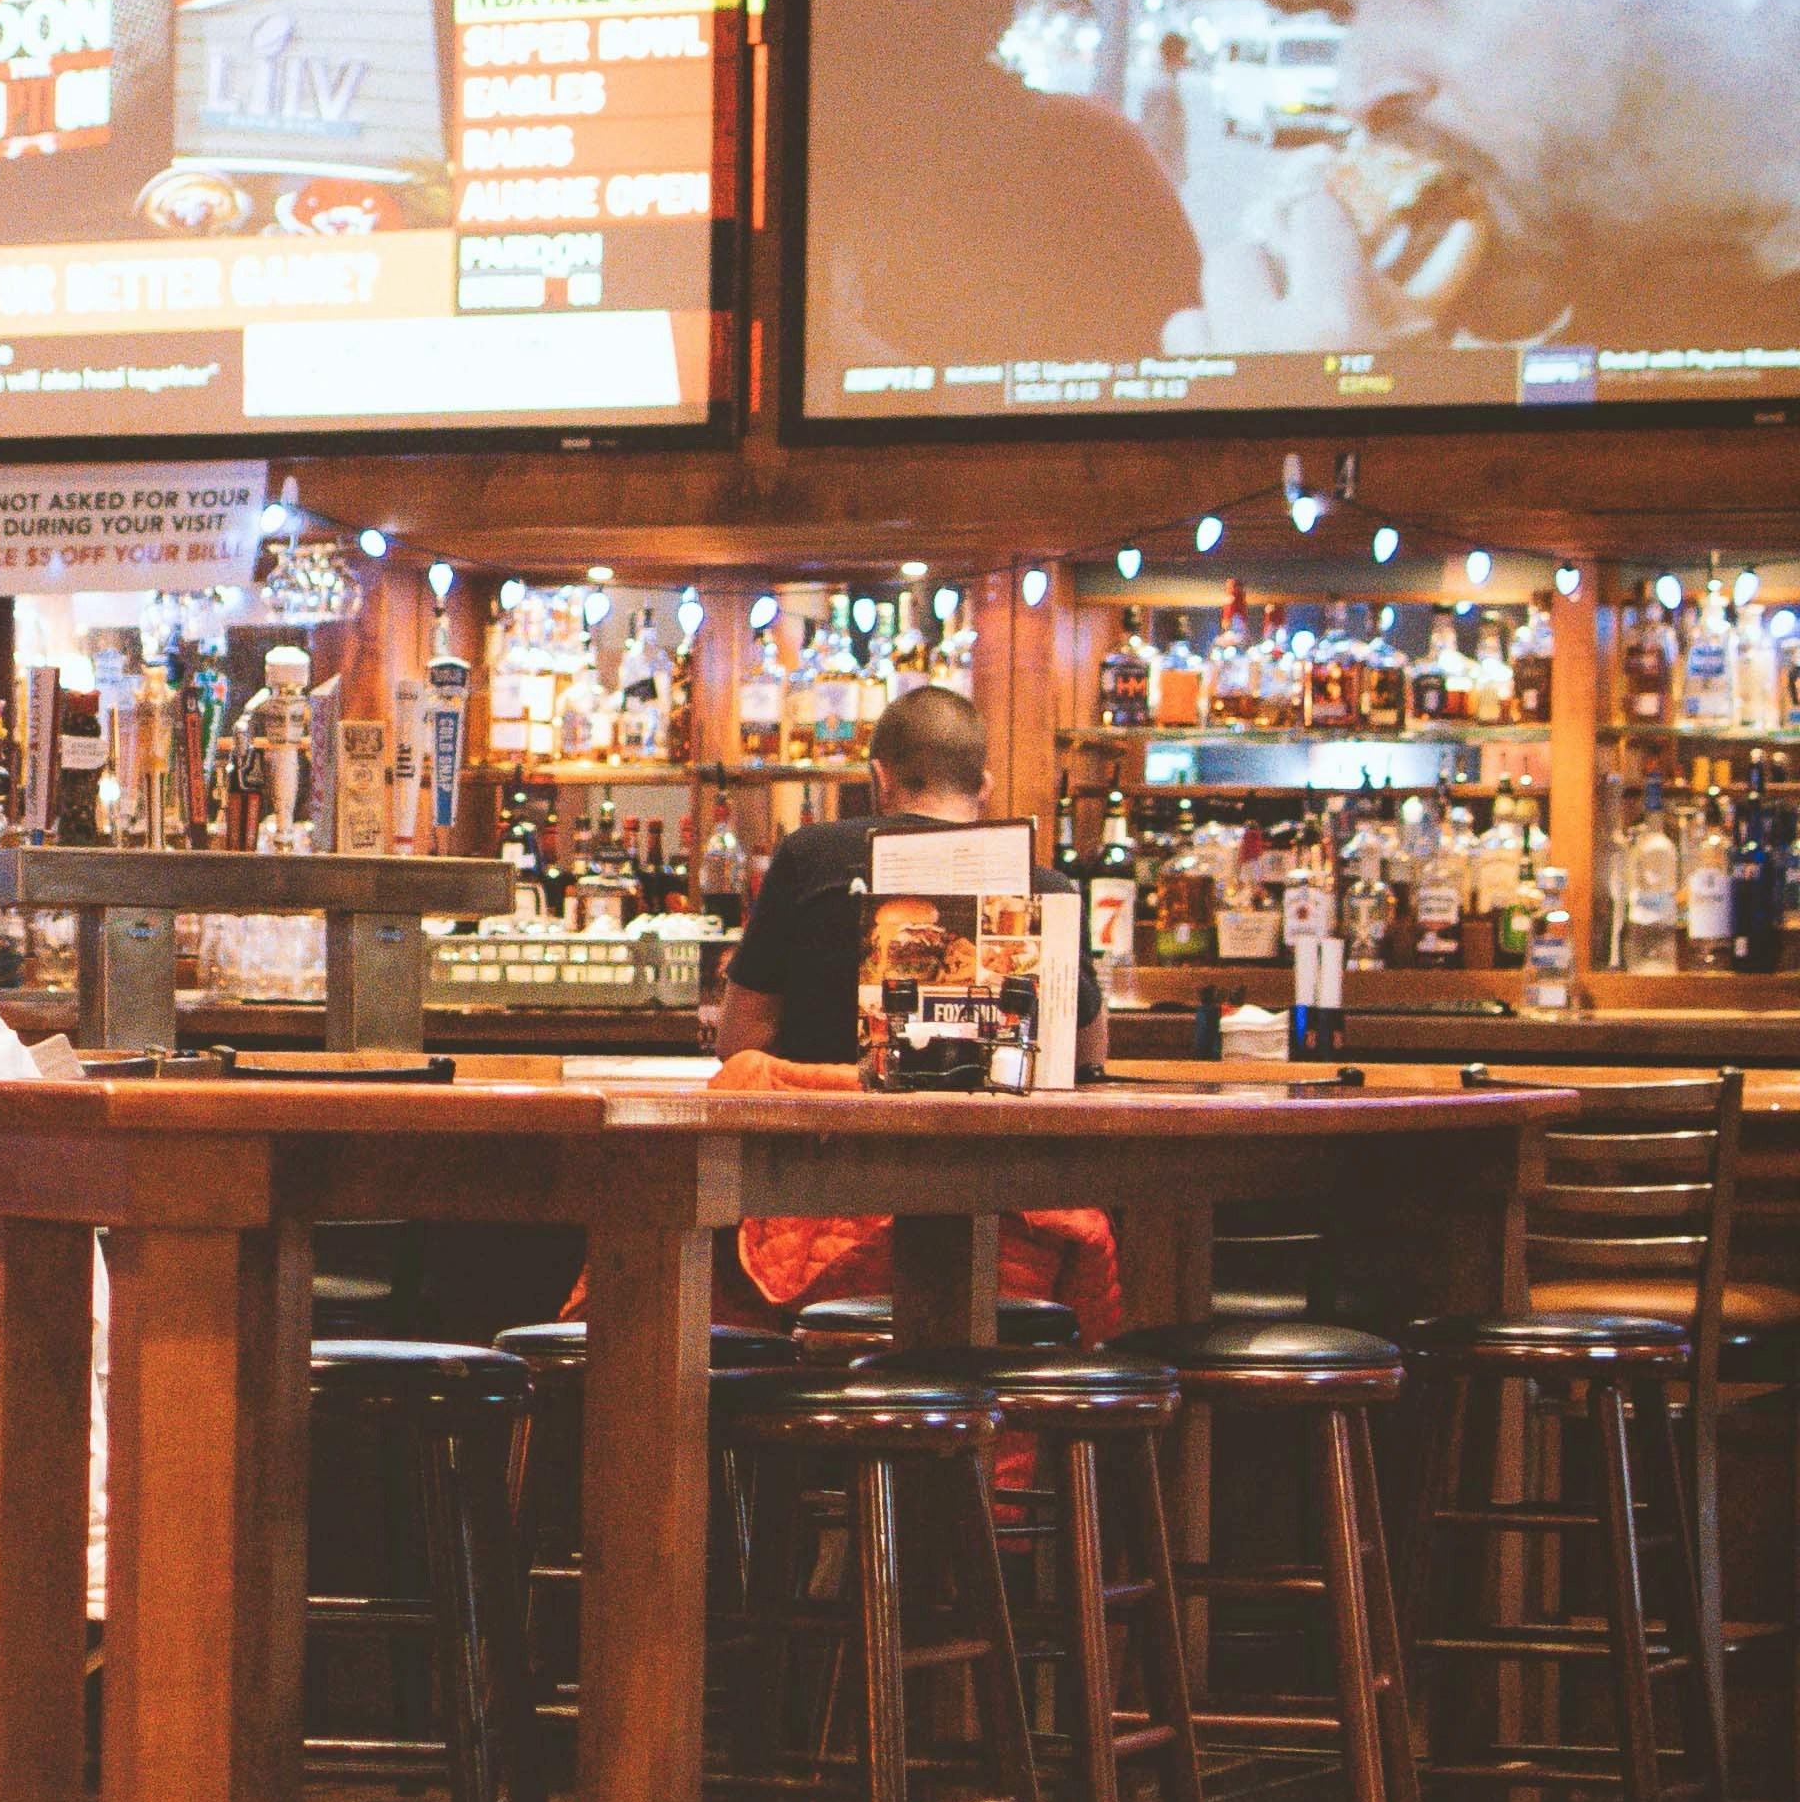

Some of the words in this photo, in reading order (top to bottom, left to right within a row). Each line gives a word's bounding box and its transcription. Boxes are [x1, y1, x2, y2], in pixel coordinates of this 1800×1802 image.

[463, 21, 590, 66] SUPER
[599, 16, 708, 60] BOWL
[463, 72, 605, 118] EAGLES
[463, 127, 574, 170] RAMS
[459, 177, 600, 221] AUSSIE
[605, 173, 709, 217] OPEN
[461, 234, 603, 275] PARDON
[65, 255, 224, 315] BETTER
[229, 252, 380, 309] GAME?
[1685, 348, 1744, 373] Peyton
[41, 369, 81, 392] also
[48, 490, 125, 511] ASKED
[133, 489, 180, 510] FOR
[186, 488, 251, 508] YOUR
[3, 516, 92, 536] DURING
[101, 514, 166, 534] YOUR
[172, 513, 227, 532] VISIT
[24, 545, 55, 568] $5
[61, 544, 106, 565] OFF
[114, 543, 179, 564] YOUR
[437, 717, 454, 755] COLD
[395, 743, 416, 779] Lite
[436, 755, 453, 793] SNAP
[1095, 897, 1125, 945] 7
